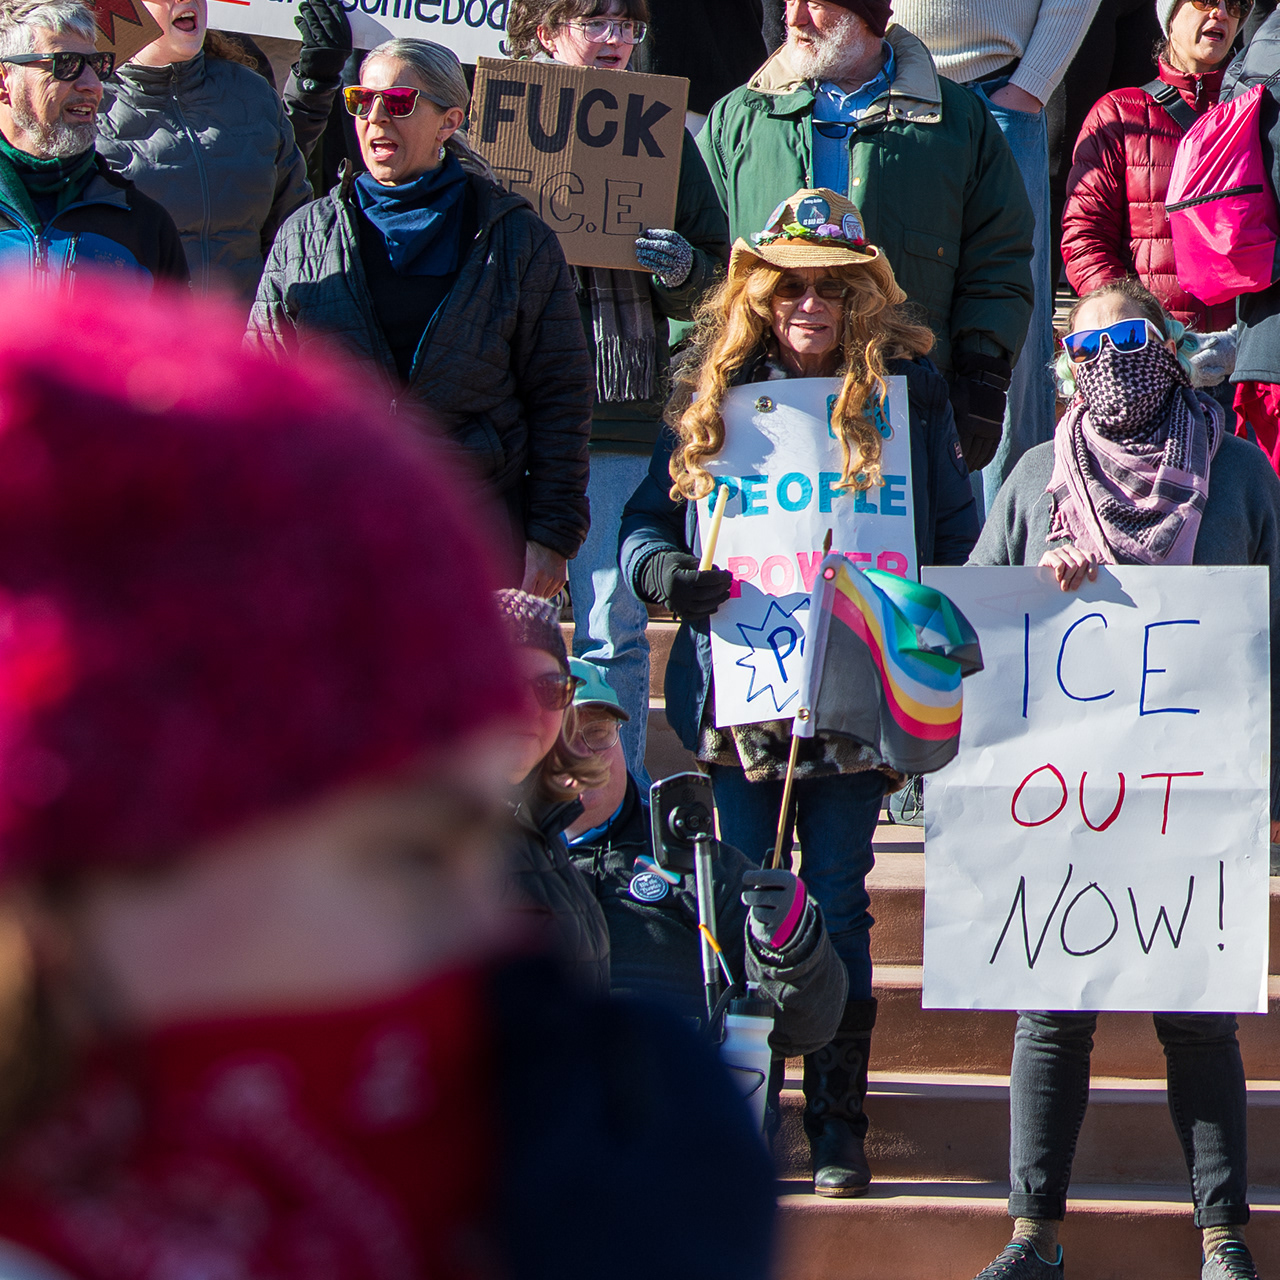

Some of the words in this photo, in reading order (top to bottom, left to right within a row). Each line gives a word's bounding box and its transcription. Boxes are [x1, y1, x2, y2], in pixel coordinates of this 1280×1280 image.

[481, 78, 673, 159] FUCK
[708, 471, 908, 519] PEOPLE
[1022, 612, 1202, 718] ICE
[1011, 762, 1204, 835] OUT
[989, 859, 1225, 969] NOW!
